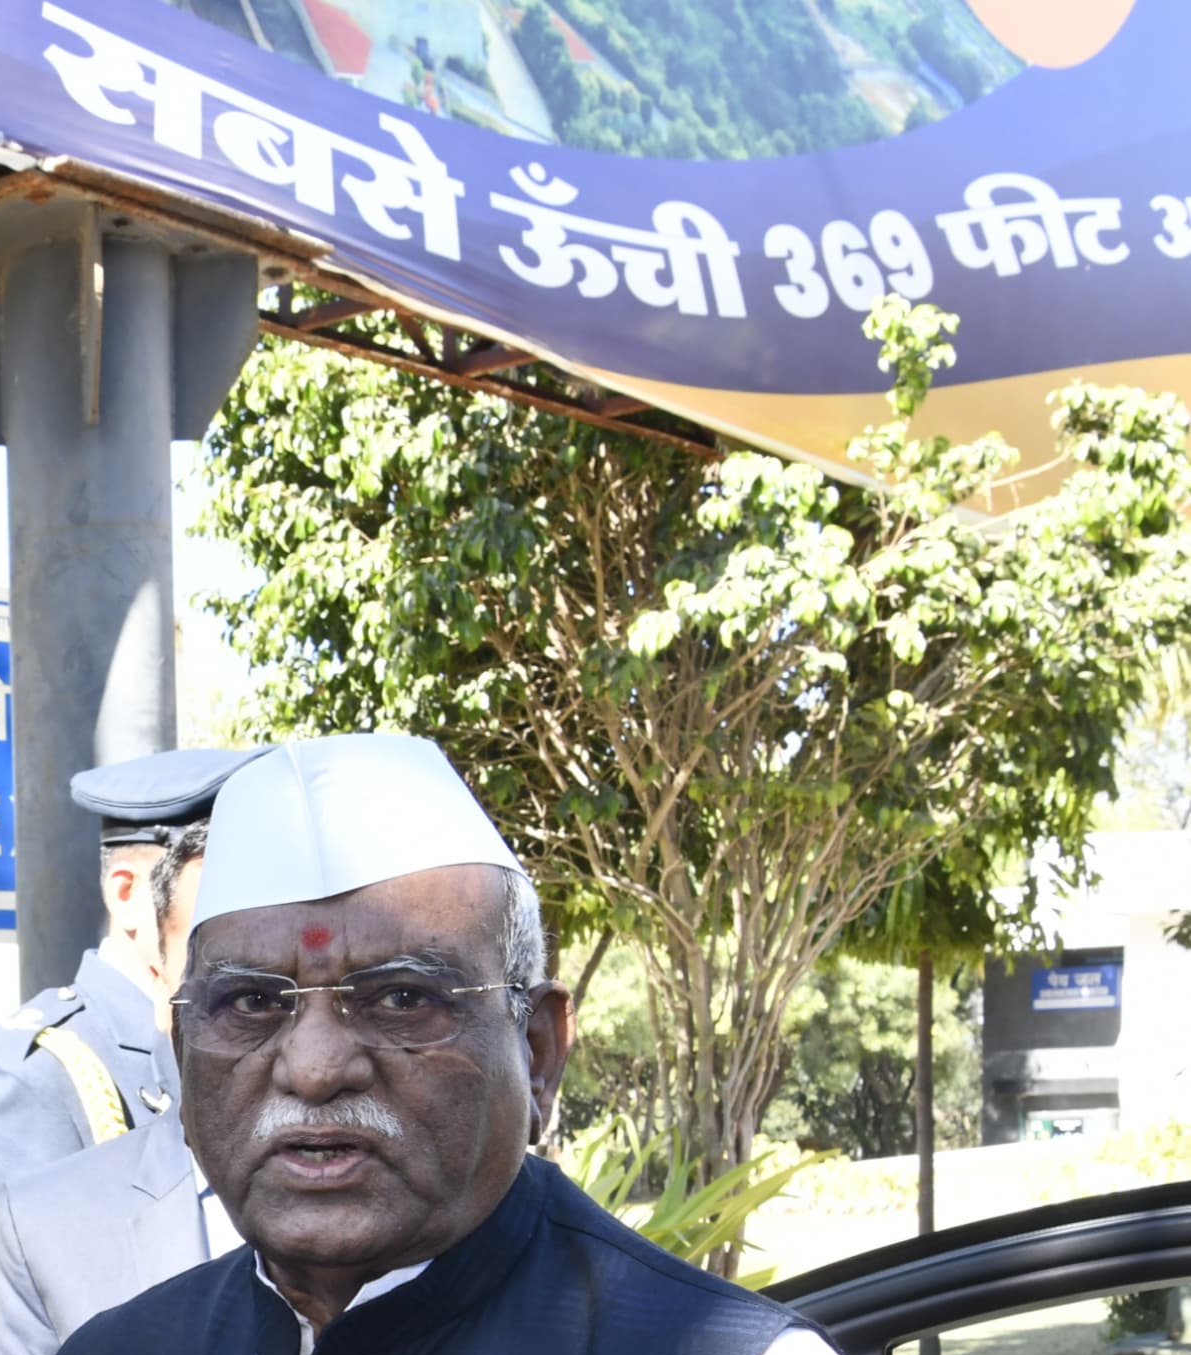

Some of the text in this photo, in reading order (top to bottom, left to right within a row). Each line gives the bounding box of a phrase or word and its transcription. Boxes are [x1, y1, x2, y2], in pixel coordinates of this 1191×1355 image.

[41, 2, 466, 261] सबसे
[490, 161, 747, 318] ऊँची
[764, 209, 934, 319] 369
[936, 172, 1130, 277] फीट
